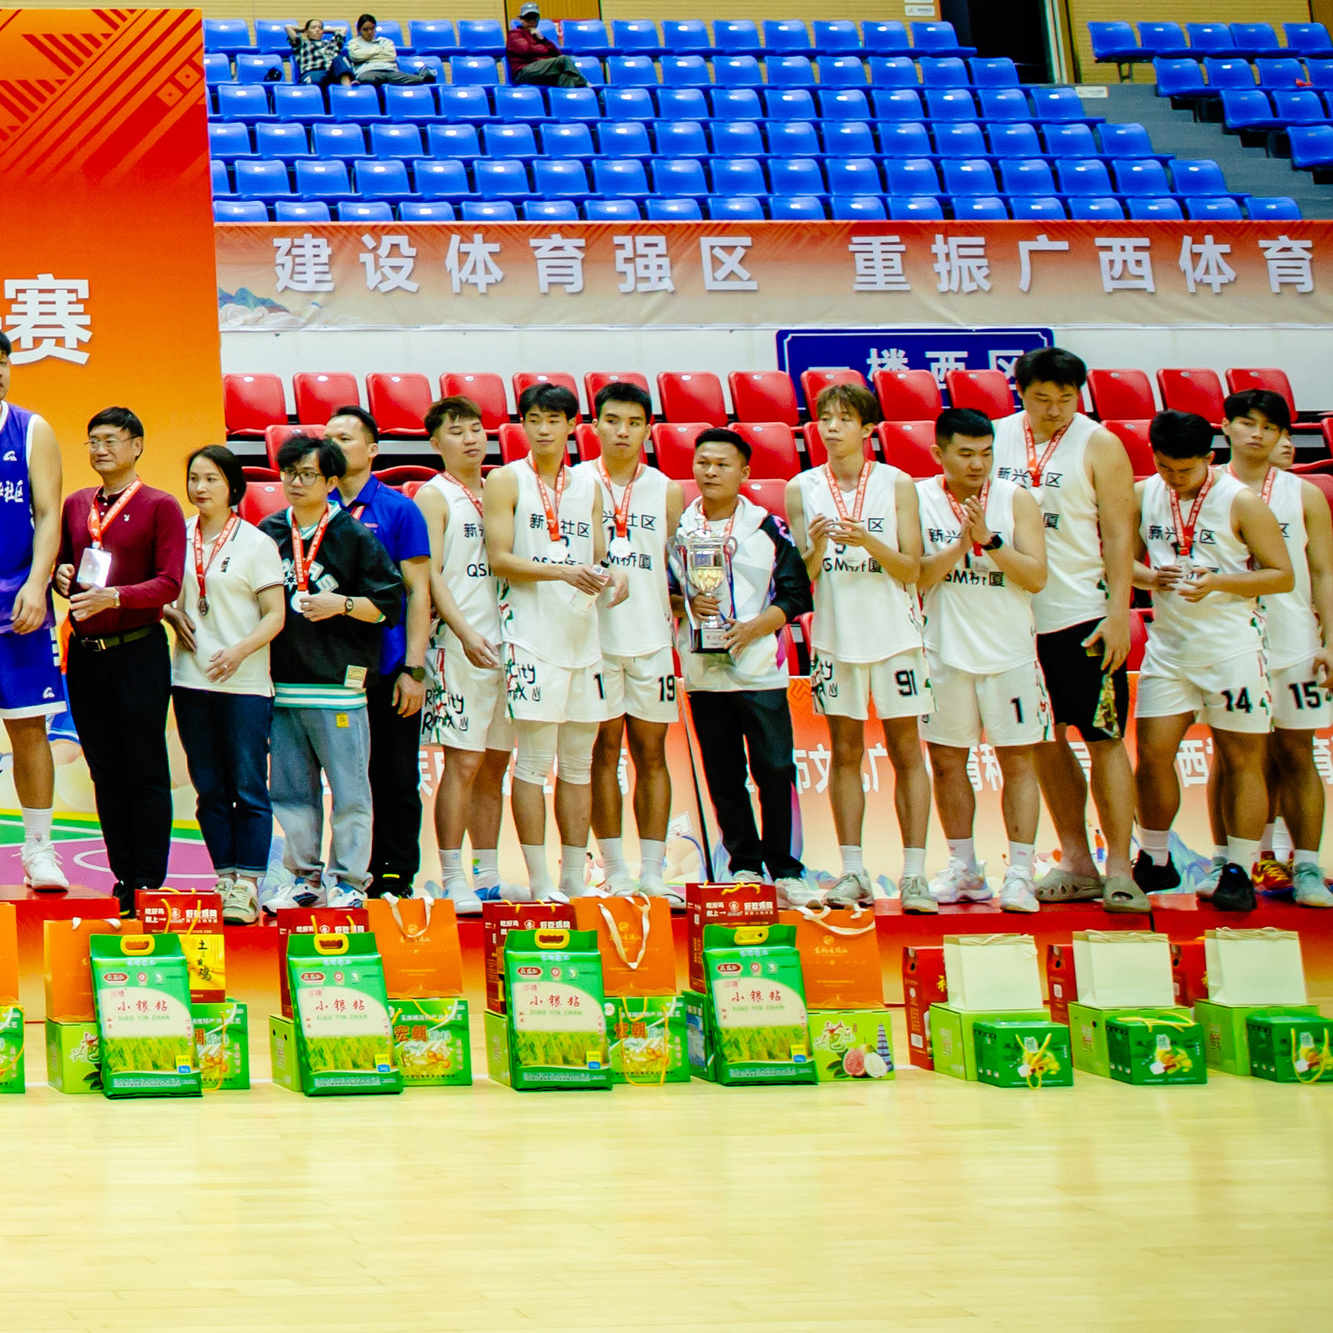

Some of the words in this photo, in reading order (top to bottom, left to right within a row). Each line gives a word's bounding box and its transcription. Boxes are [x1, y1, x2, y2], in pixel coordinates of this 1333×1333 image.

[275, 235, 758, 296] 建设体育强区
[850, 234, 1316, 296] 重振广西体育
[997, 467, 1063, 488] 新兴区
[530, 513, 590, 538] 新社区
[1148, 525, 1216, 545] 新兴区
[658, 674, 676, 702] 19
[894, 669, 917, 696] 91
[1288, 681, 1322, 710] 15
[1010, 697, 1023, 723] 1
[1221, 687, 1253, 713] 14
